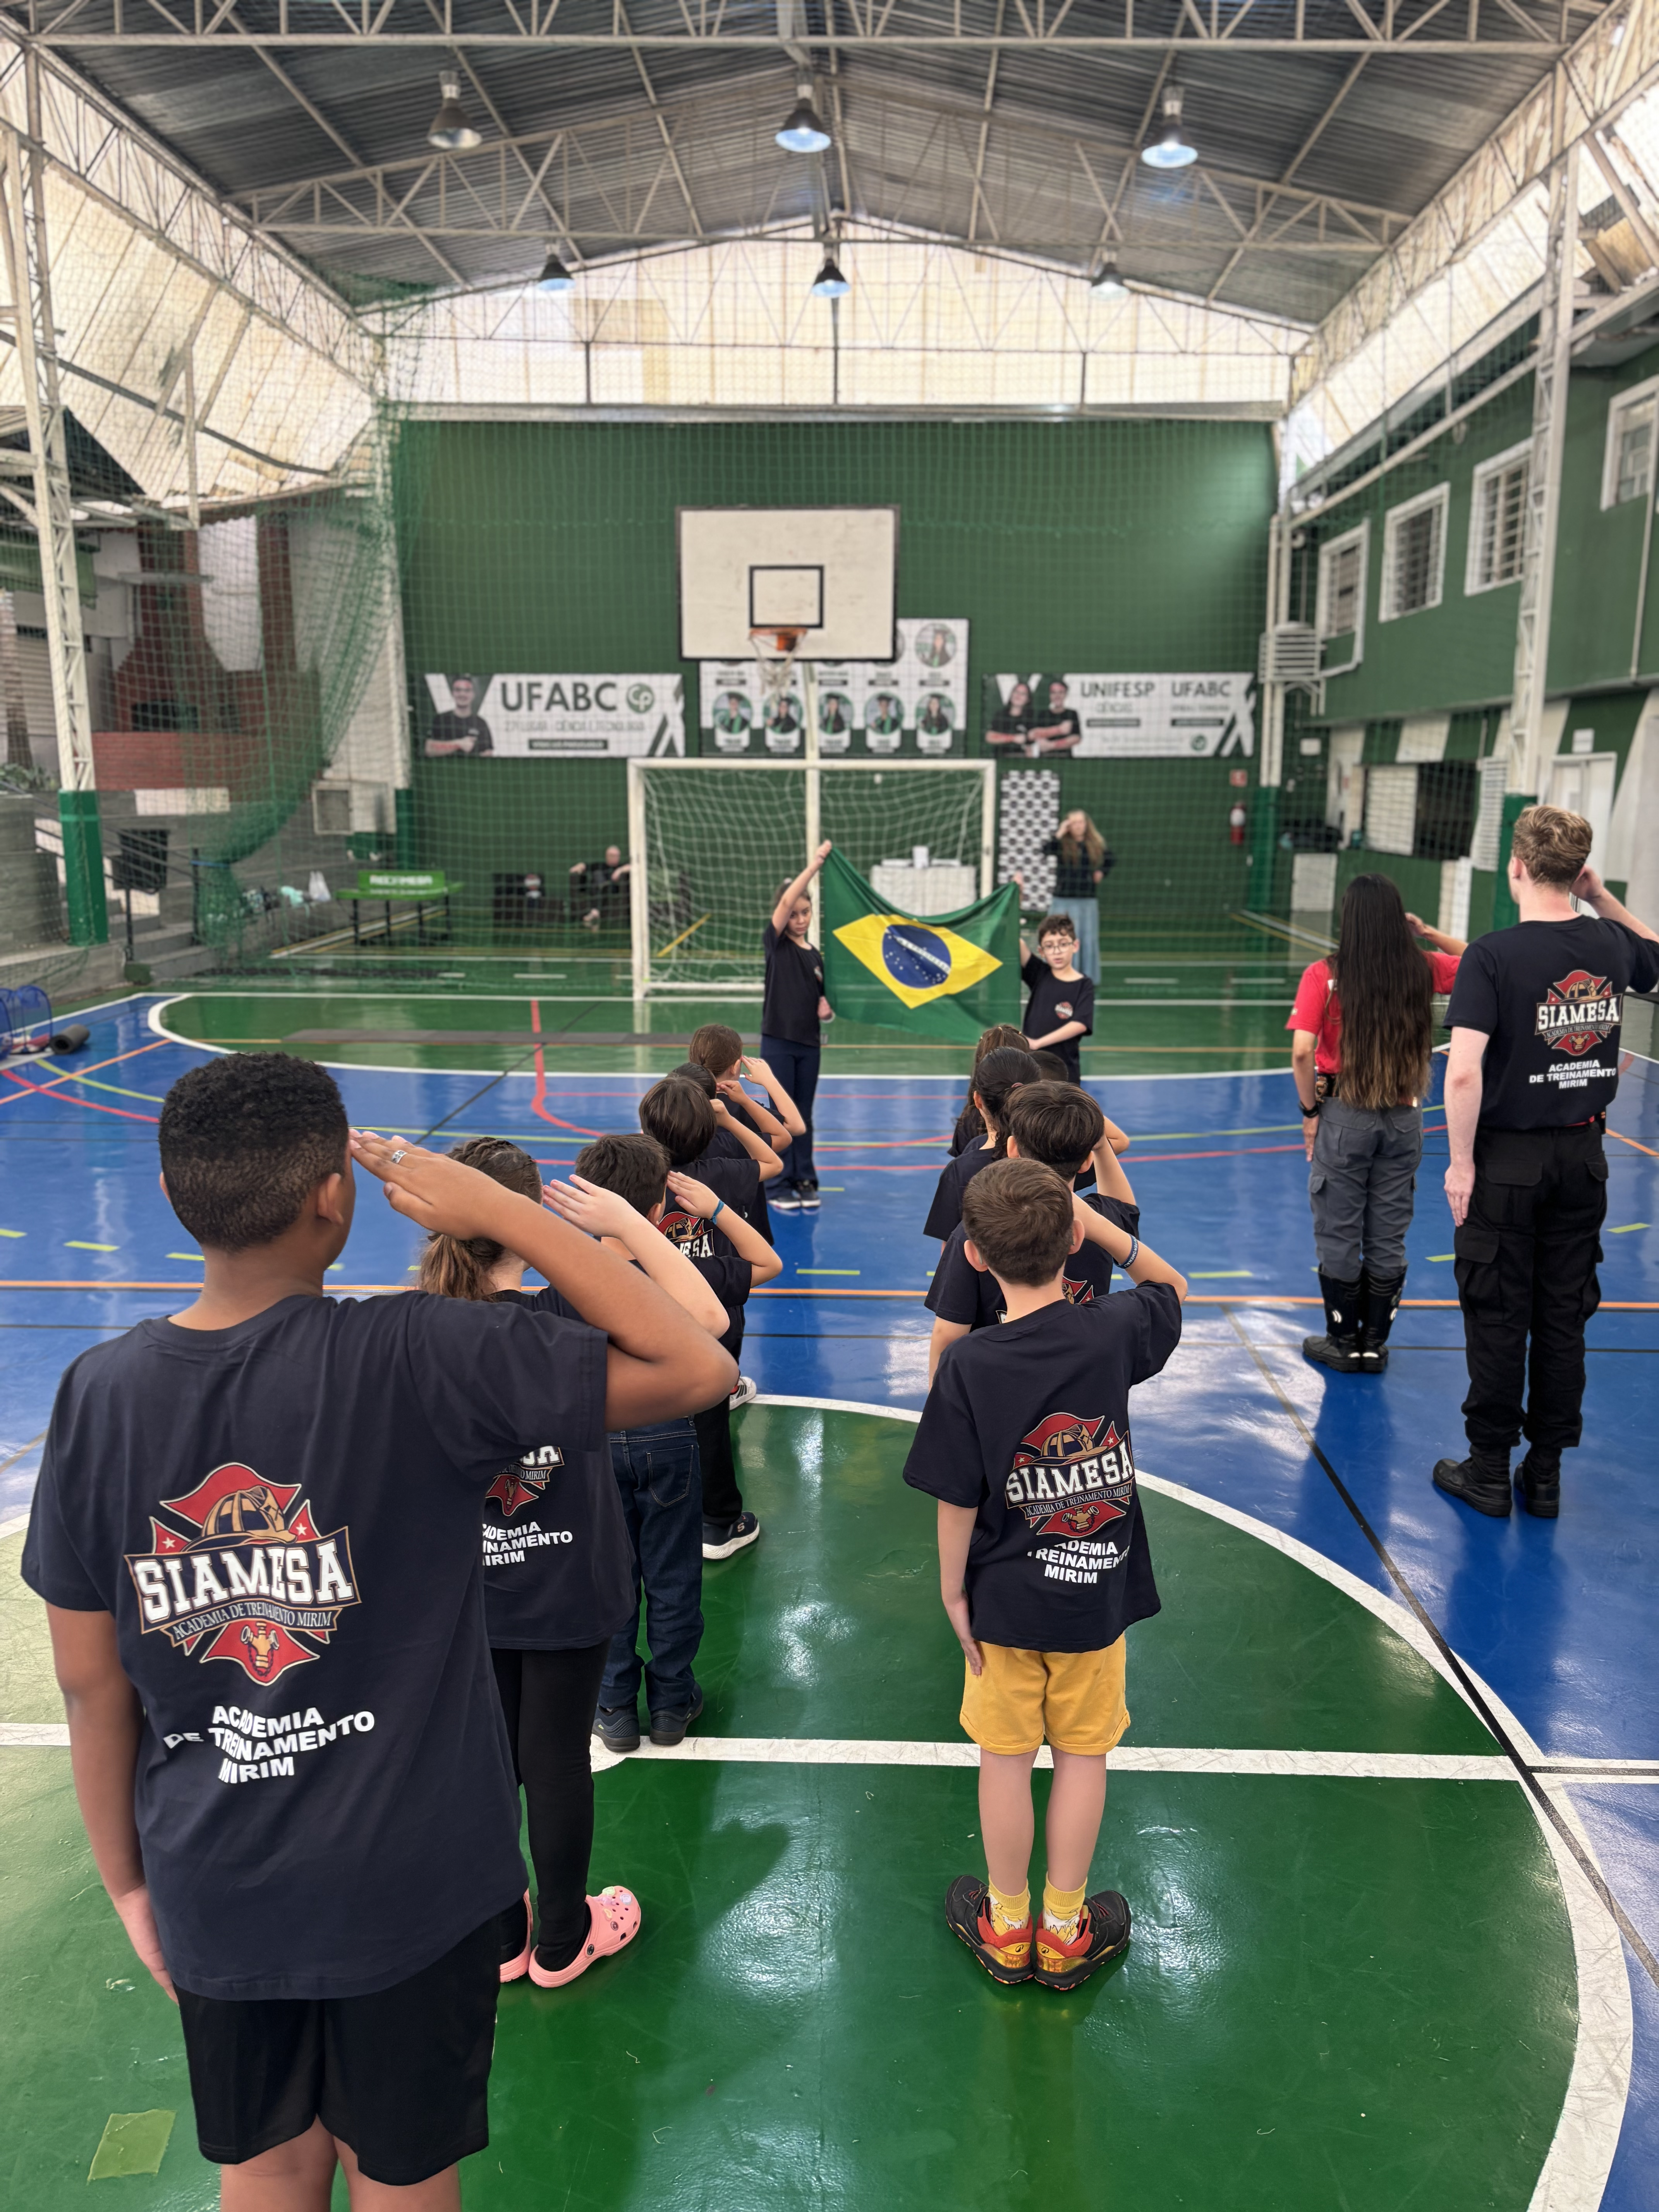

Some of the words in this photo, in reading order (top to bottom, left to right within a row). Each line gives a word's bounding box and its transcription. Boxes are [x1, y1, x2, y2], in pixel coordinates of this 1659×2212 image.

[501, 682, 617, 712] UFABC
[1081, 682, 1155, 697] UNIFESP
[1171, 681, 1231, 697] UFABC
[1538, 998, 1619, 1031] SIAMESA
[1529, 1075, 1544, 1083] DE
[1547, 1068, 1616, 1081] TREINAMENTO
[1549, 1060, 1600, 1072] ACADEMIA
[1559, 1079, 1588, 1089] MIRIM
[526, 1470, 547, 1480] MIRIM
[1006, 1441, 1133, 1502] SIAMESA
[1026, 1504, 1056, 1516] ACADEMIA
[1056, 1502, 1065, 1510] DE
[1065, 1490, 1112, 1507] TREINAMENTO
[483, 1550, 525, 1566] IRIM
[134, 1539, 353, 1622] SIAMESA
[1044, 1564, 1097, 1583] MIRIM
[173, 1609, 230, 1640] ACADEMIA
[229, 1604, 246, 1618] DE
[244, 1602, 295, 1625] TREINAMENTO
[297, 1611, 332, 1626] MIRIM
[212, 1705, 325, 1738] ACADEMIA
[163, 1732, 204, 1749] DE
[208, 1711, 375, 1761] TREINAMENTO
[218, 1756, 295, 1784] MIRIM
